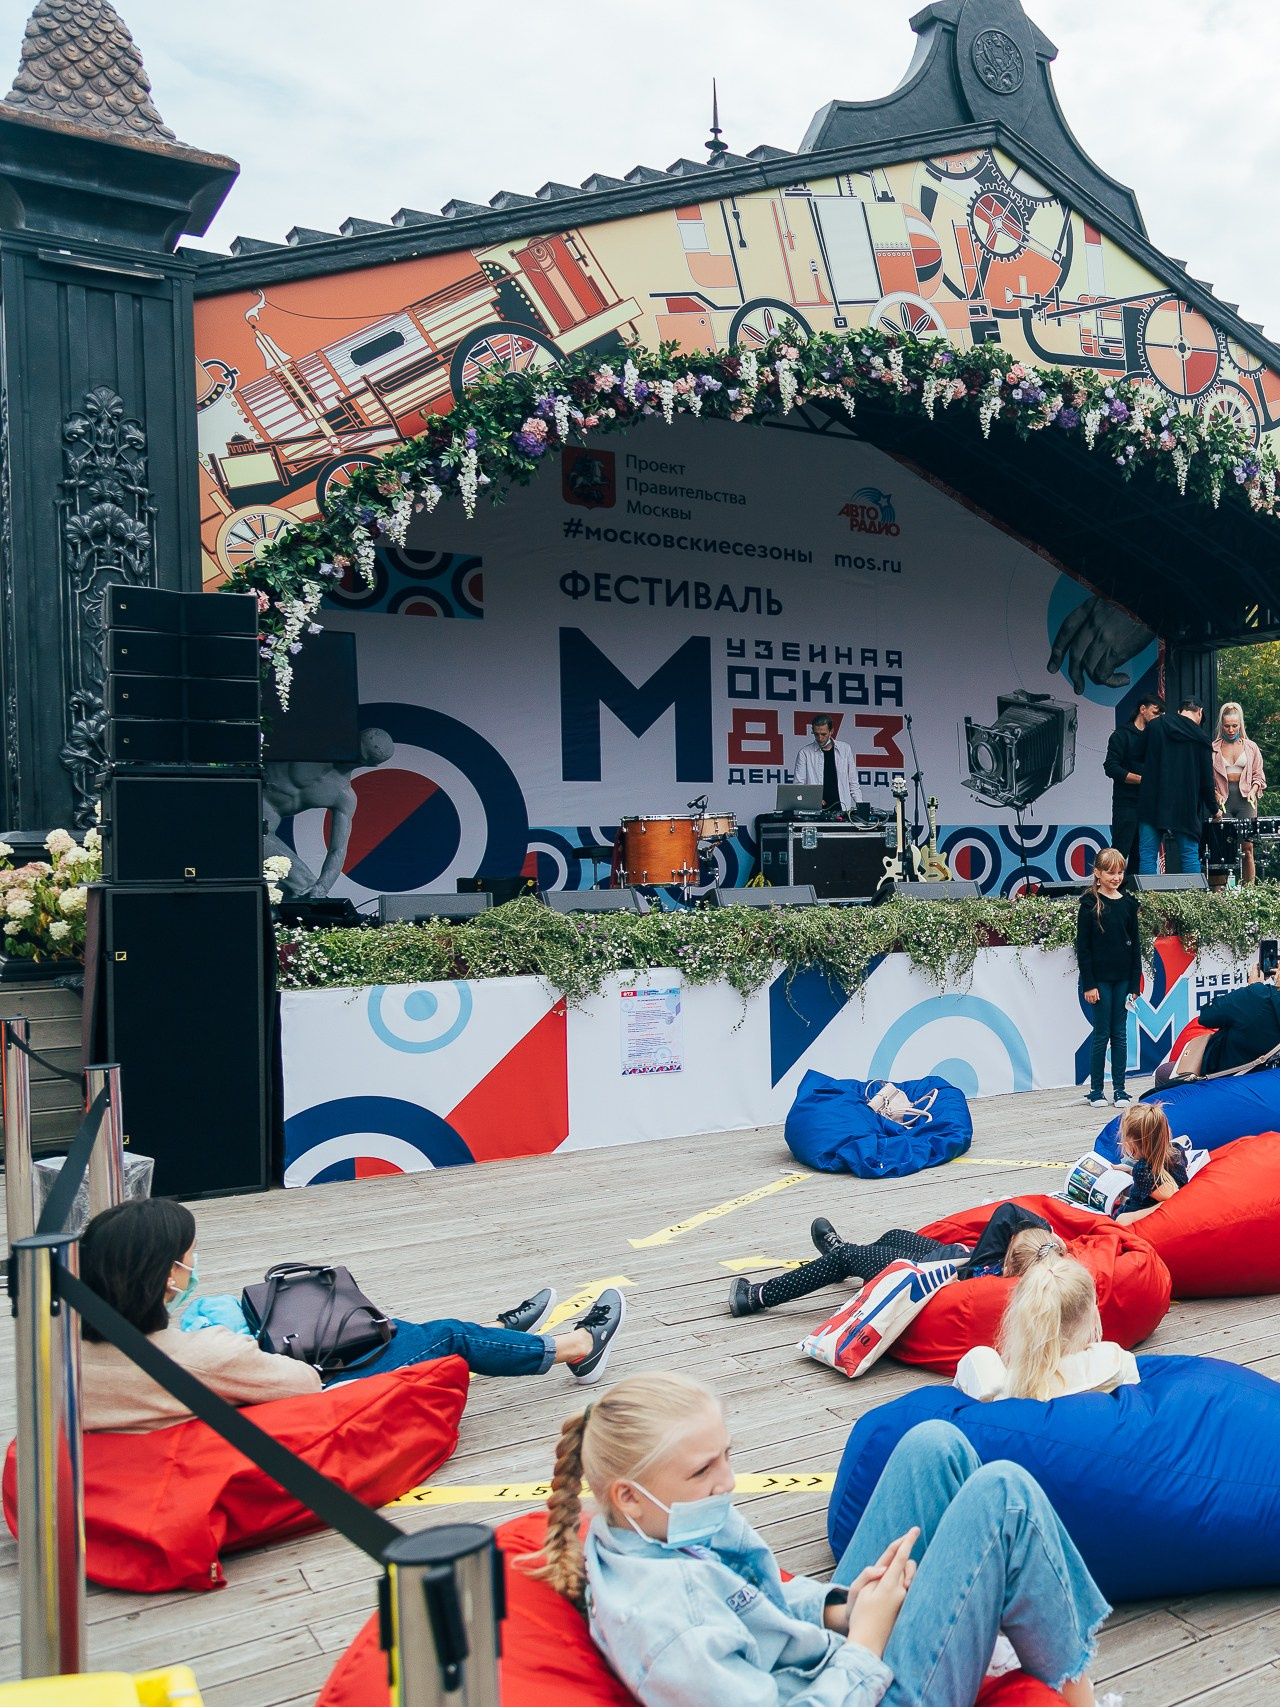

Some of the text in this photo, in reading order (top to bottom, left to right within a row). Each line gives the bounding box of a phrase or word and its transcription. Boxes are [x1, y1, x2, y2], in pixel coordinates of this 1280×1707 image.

[625, 454, 686, 475] Проект
[626, 476, 747, 505] Правительства
[626, 499, 692, 520] Москвы
[838, 503, 879, 521] АВТО
[850, 518, 900, 537] РАДИО
[562, 517, 813, 564] #московскиесезоны
[835, 553, 902, 574] mos.ru
[559, 569, 783, 616] ФЕСТИВАЛЬ
[727, 665, 903, 707] ОСКВА
[728, 768, 794, 785] ДЕНЬ
